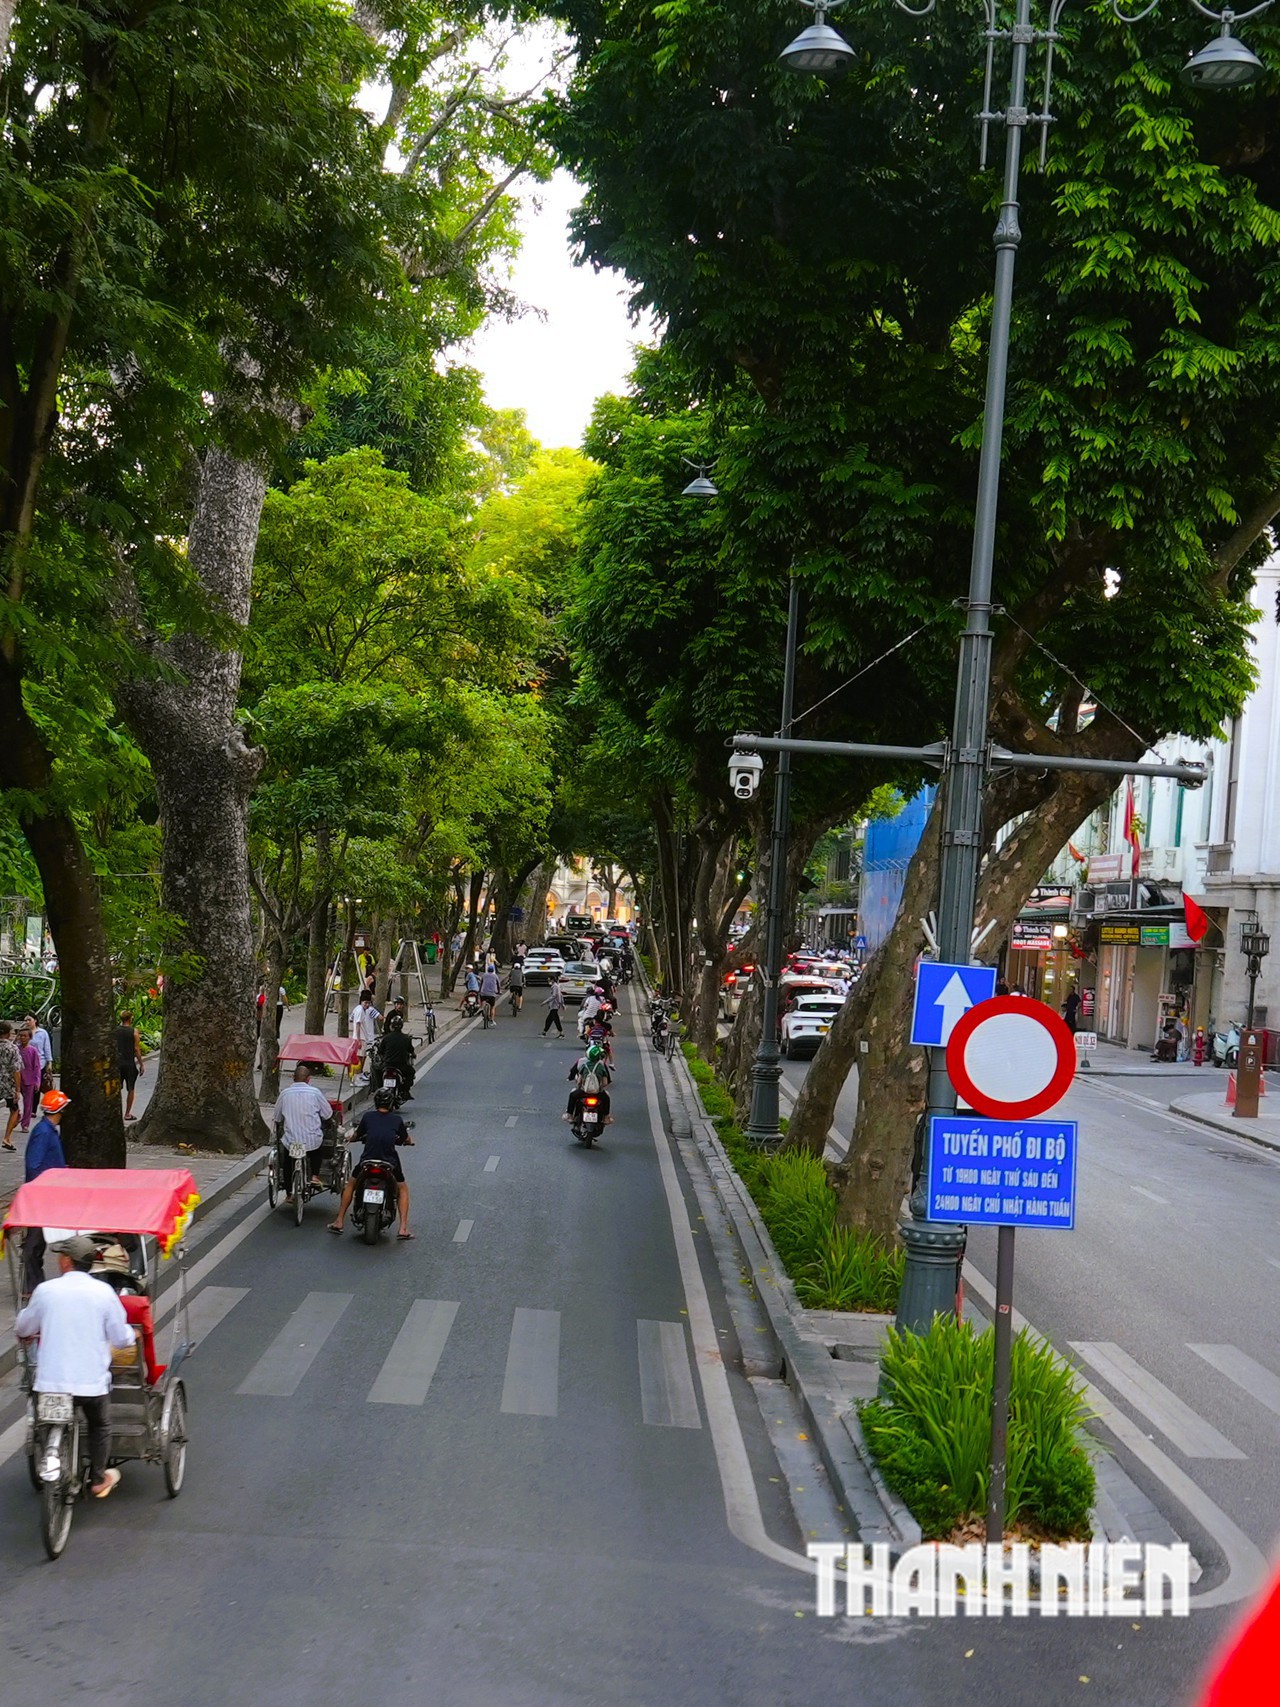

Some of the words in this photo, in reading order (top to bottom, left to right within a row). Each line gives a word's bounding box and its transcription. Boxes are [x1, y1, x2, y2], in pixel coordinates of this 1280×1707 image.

[942, 1128, 988, 1157] TUYẾN
[992, 1130, 1023, 1159] PHỐ
[1026, 1136, 1041, 1160] ĐI
[1045, 1133, 1066, 1165] BỘ
[942, 1164, 954, 1183] TỪ
[956, 1168, 978, 1184] 19H00
[980, 1166, 1001, 1186] NGÀY
[1004, 1167, 1021, 1187] THỨ
[1022, 1168, 1039, 1188] SÁU
[1041, 1168, 1059, 1189] ĐẾN
[935, 1194, 960, 1211] 24H00
[961, 1193, 982, 1212] NGÀY
[984, 1192, 1001, 1214] CHỦ
[1002, 1195, 1024, 1218] NHẬT
[1026, 1197, 1048, 1217] HÀNG
